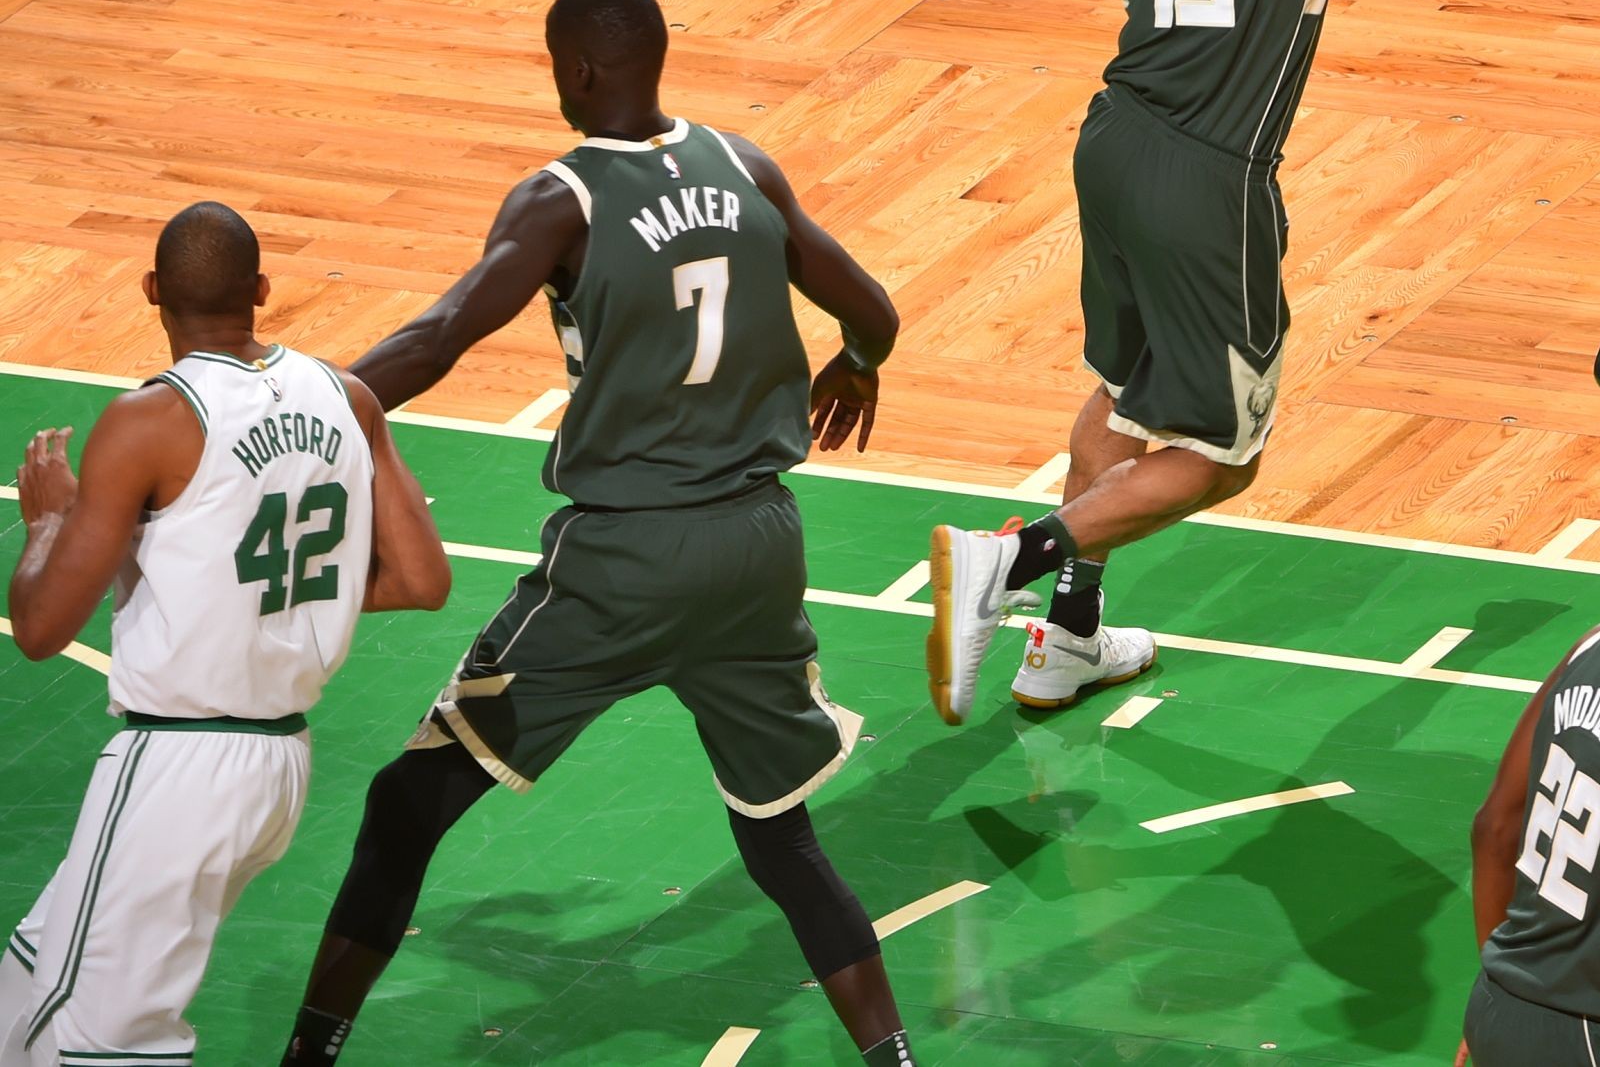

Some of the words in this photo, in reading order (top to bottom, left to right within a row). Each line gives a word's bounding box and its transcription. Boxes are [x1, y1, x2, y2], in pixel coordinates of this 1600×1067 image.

[629, 186, 741, 253] MAKER
[672, 256, 730, 386] 7
[231, 412, 343, 479] HORFORD
[234, 481, 349, 617] 42
